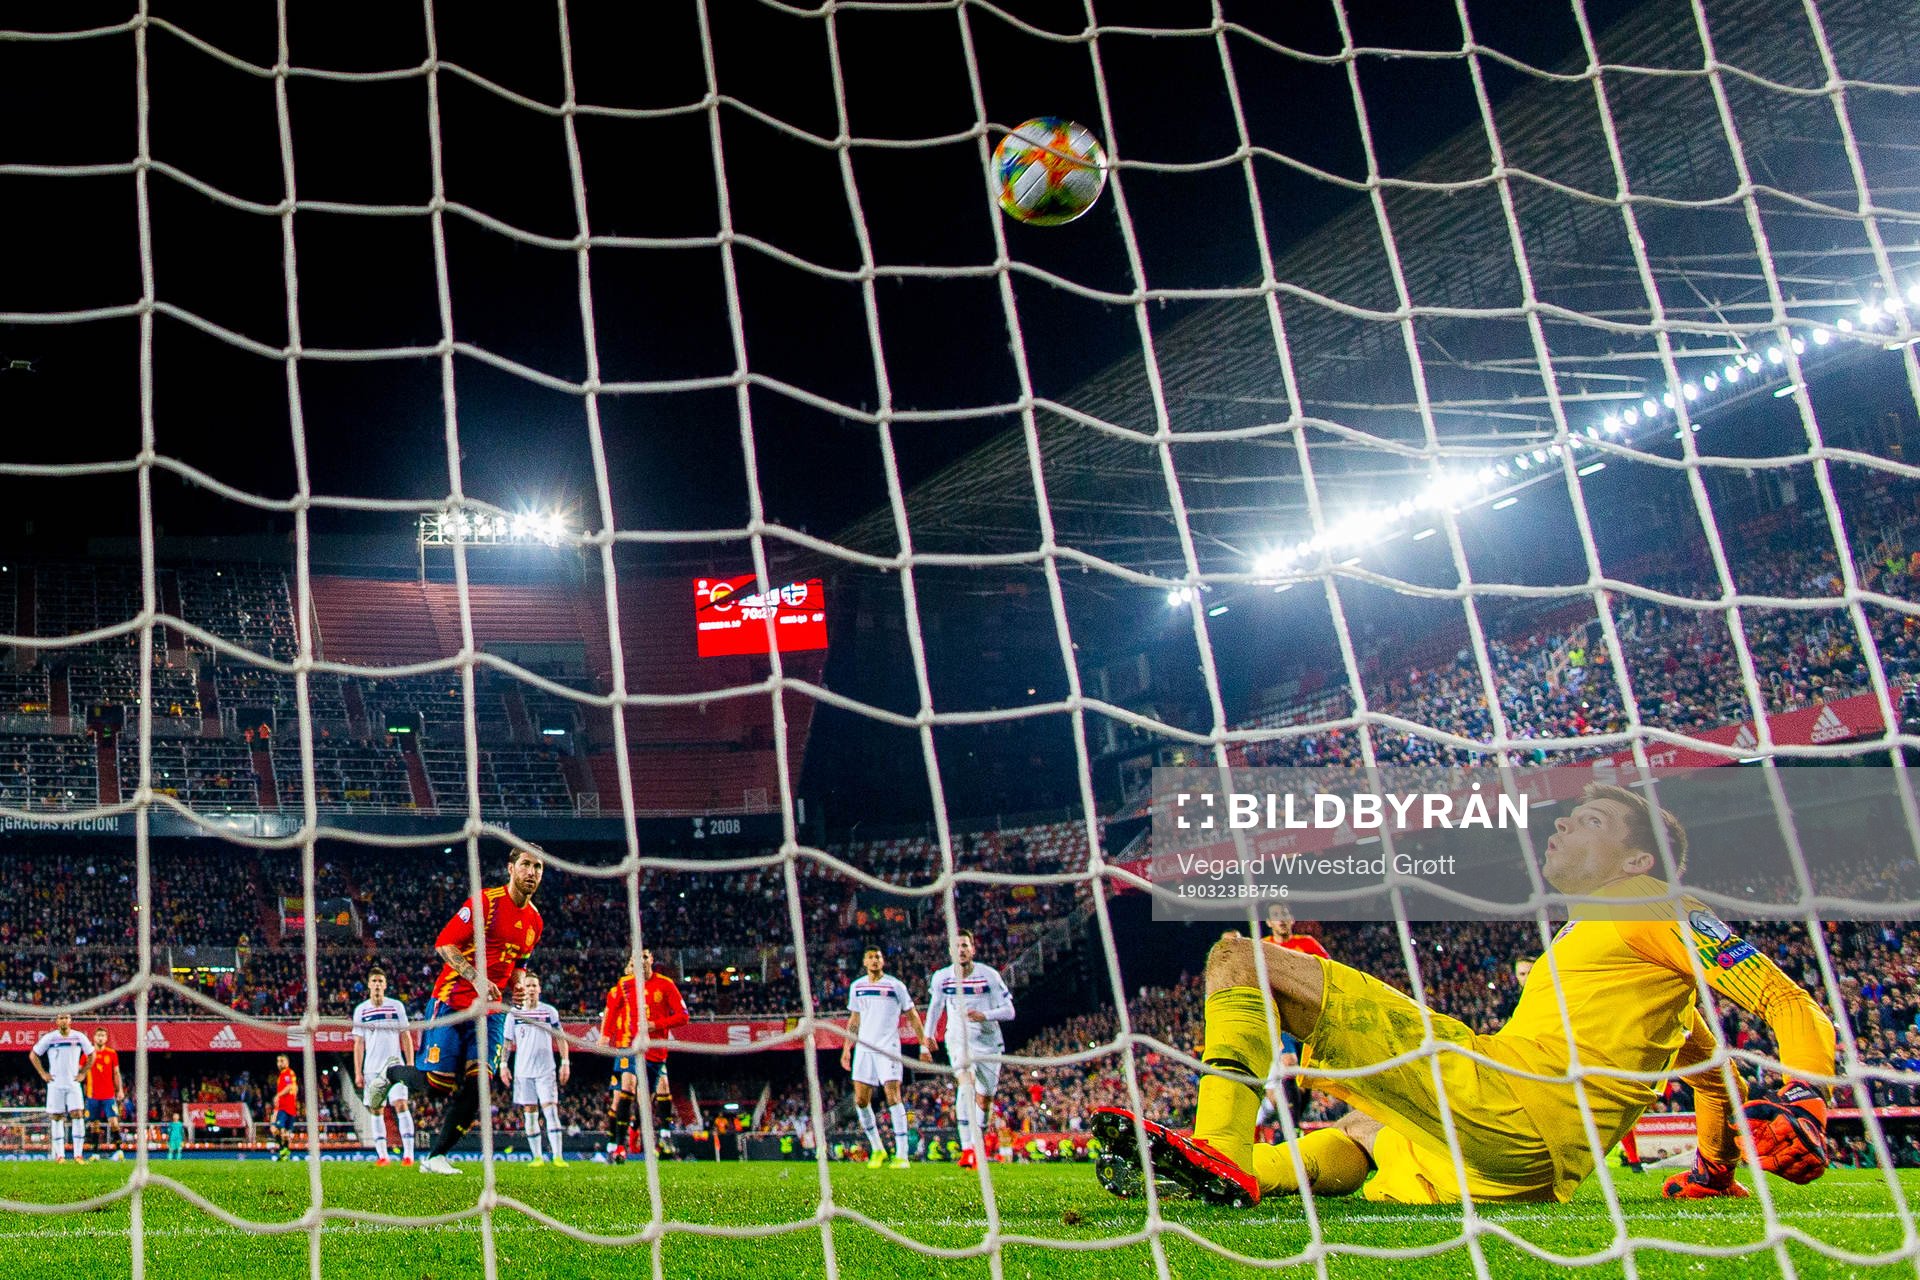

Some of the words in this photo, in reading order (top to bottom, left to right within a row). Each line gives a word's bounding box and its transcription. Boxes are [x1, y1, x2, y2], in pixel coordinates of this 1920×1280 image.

[1621, 750, 1677, 774] SAT
[710, 820, 741, 835] 2008
[499, 942, 521, 964] 15
[15, 1030, 36, 1045] DE
[315, 1031, 354, 1042] SEA
